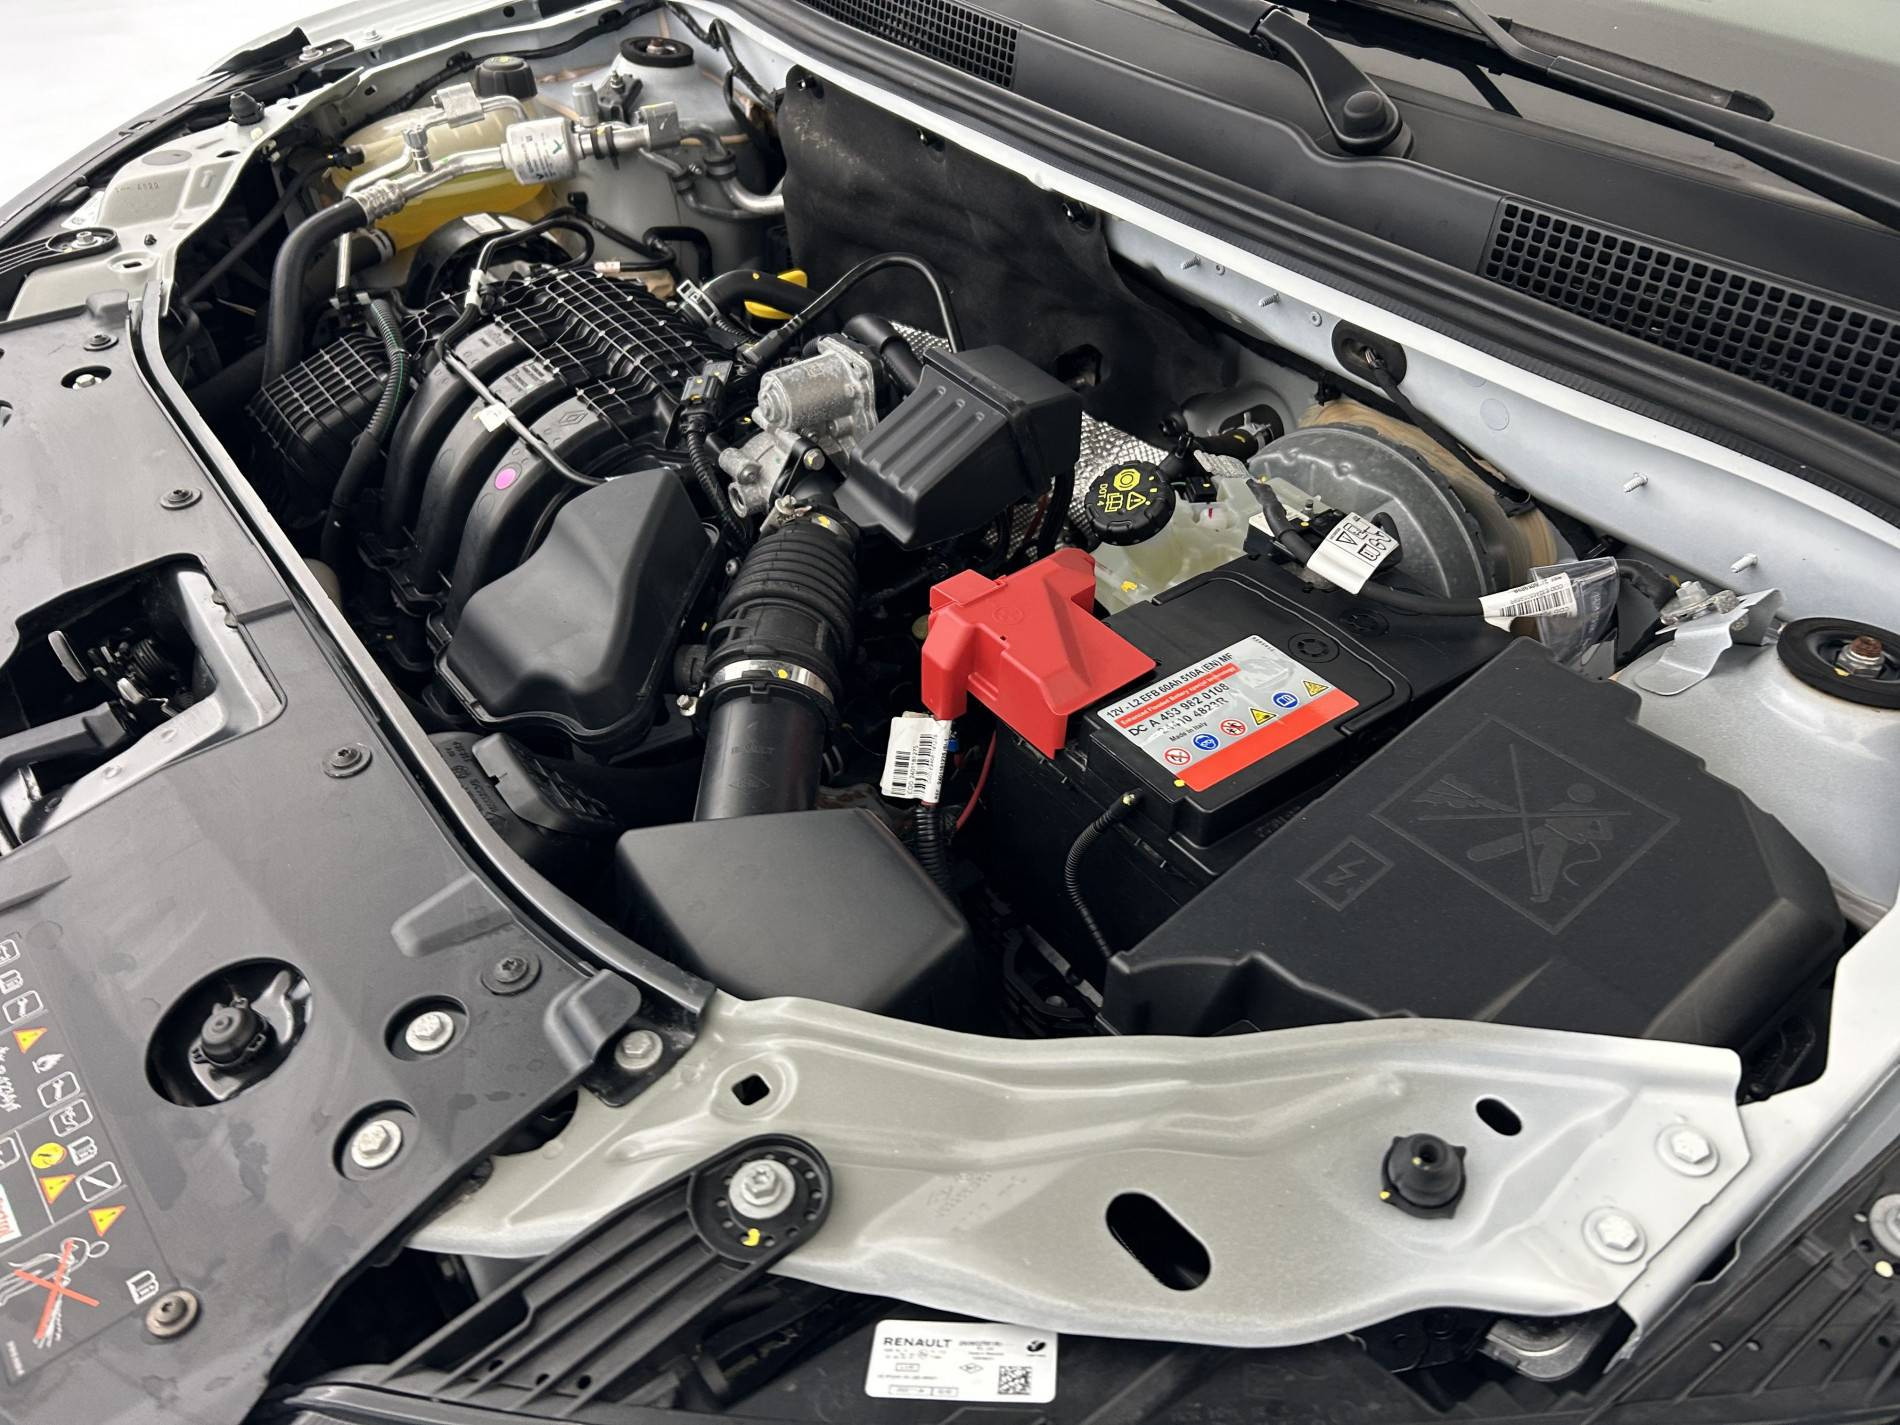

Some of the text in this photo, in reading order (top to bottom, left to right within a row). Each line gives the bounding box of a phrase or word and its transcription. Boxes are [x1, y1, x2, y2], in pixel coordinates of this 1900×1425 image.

[1098, 484, 1108, 498] DOT
[1106, 706, 1125, 719] 12V
[1128, 698, 1143, 709] L2
[1139, 689, 1161, 702] EFB
[1159, 678, 1183, 693] 60Ah
[1179, 667, 1203, 682] 510A
[1200, 659, 1223, 673] (EN)
[1221, 652, 1234, 664] MF
[1128, 682, 1230, 737] DC A 453 982 0108
[1193, 697, 1230, 718] 4823R
[1169, 733, 1184, 742] Made
[1192, 720, 1208, 732] Italy
[883, 1337, 952, 1349] RENAULT
